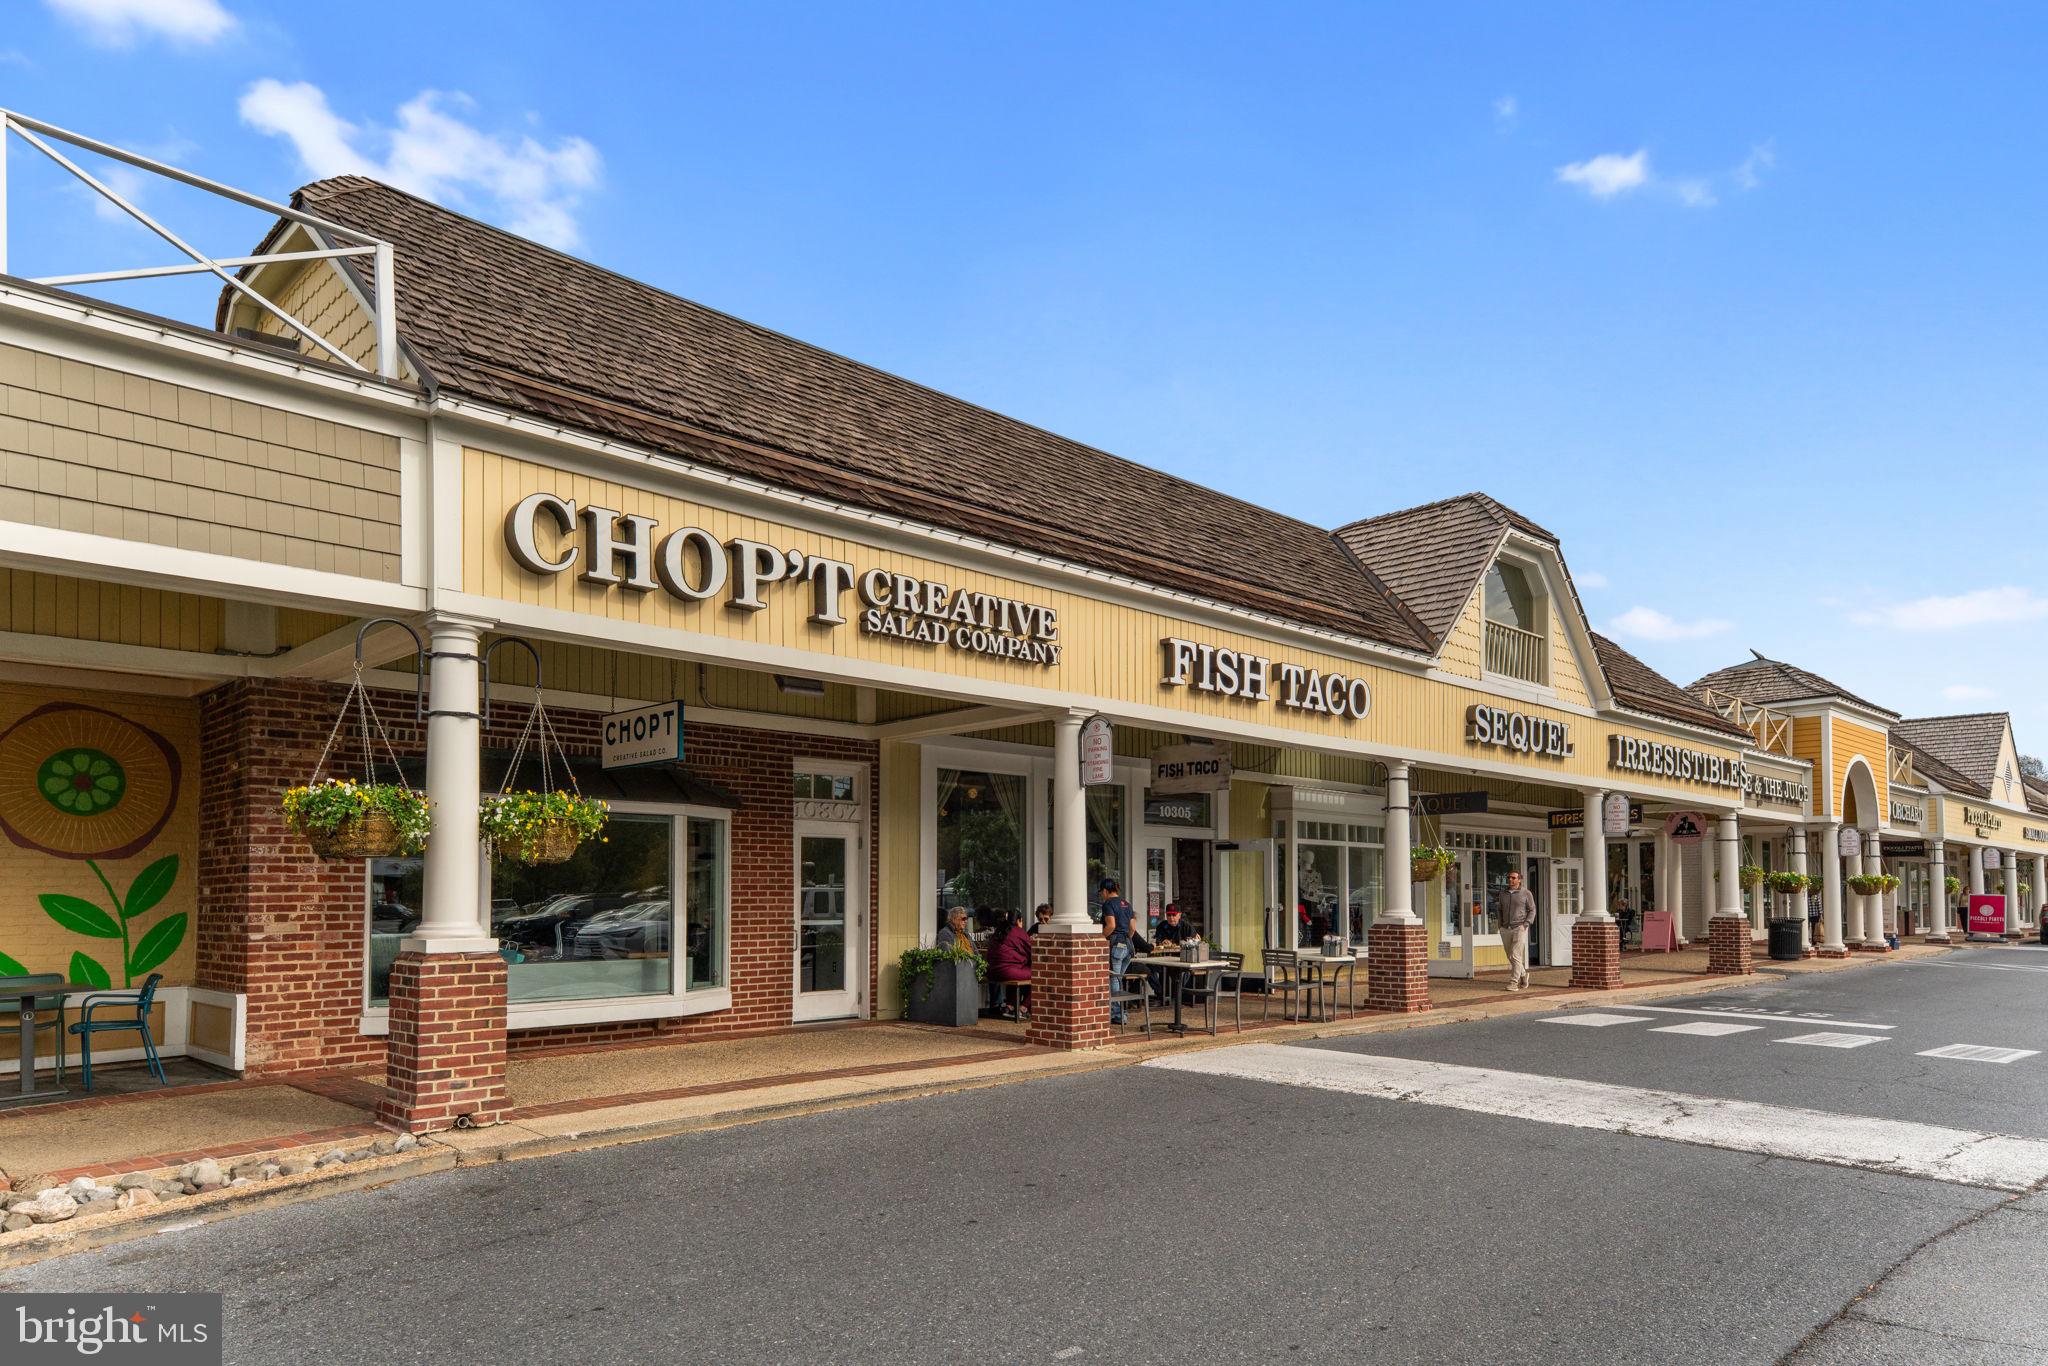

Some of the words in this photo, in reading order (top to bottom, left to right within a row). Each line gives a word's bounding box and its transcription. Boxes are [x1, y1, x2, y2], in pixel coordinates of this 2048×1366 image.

[504, 492, 855, 626] CHOP'T
[858, 568, 1058, 641] CREATIVE
[860, 608, 950, 645] SALAD
[951, 627, 1062, 666] COMPANY
[1160, 637, 1271, 702] FISH
[1272, 662, 1371, 720] TACO
[605, 710, 675, 746] CHOPT
[1093, 737, 1102, 746] NO
[1466, 703, 1576, 758] SEQUEL
[613, 751, 638, 762] CREATIVE
[639, 748, 657, 758] SALAD
[1158, 763, 1184, 778] FISH
[1187, 759, 1219, 775] TACO
[1608, 734, 1749, 790] IRRESISTIBLES
[1754, 775, 1762, 794] &
[1763, 776, 1783, 798] THE
[1784, 780, 1809, 801] JUICE
[1892, 801, 1923, 822] ORCHARD
